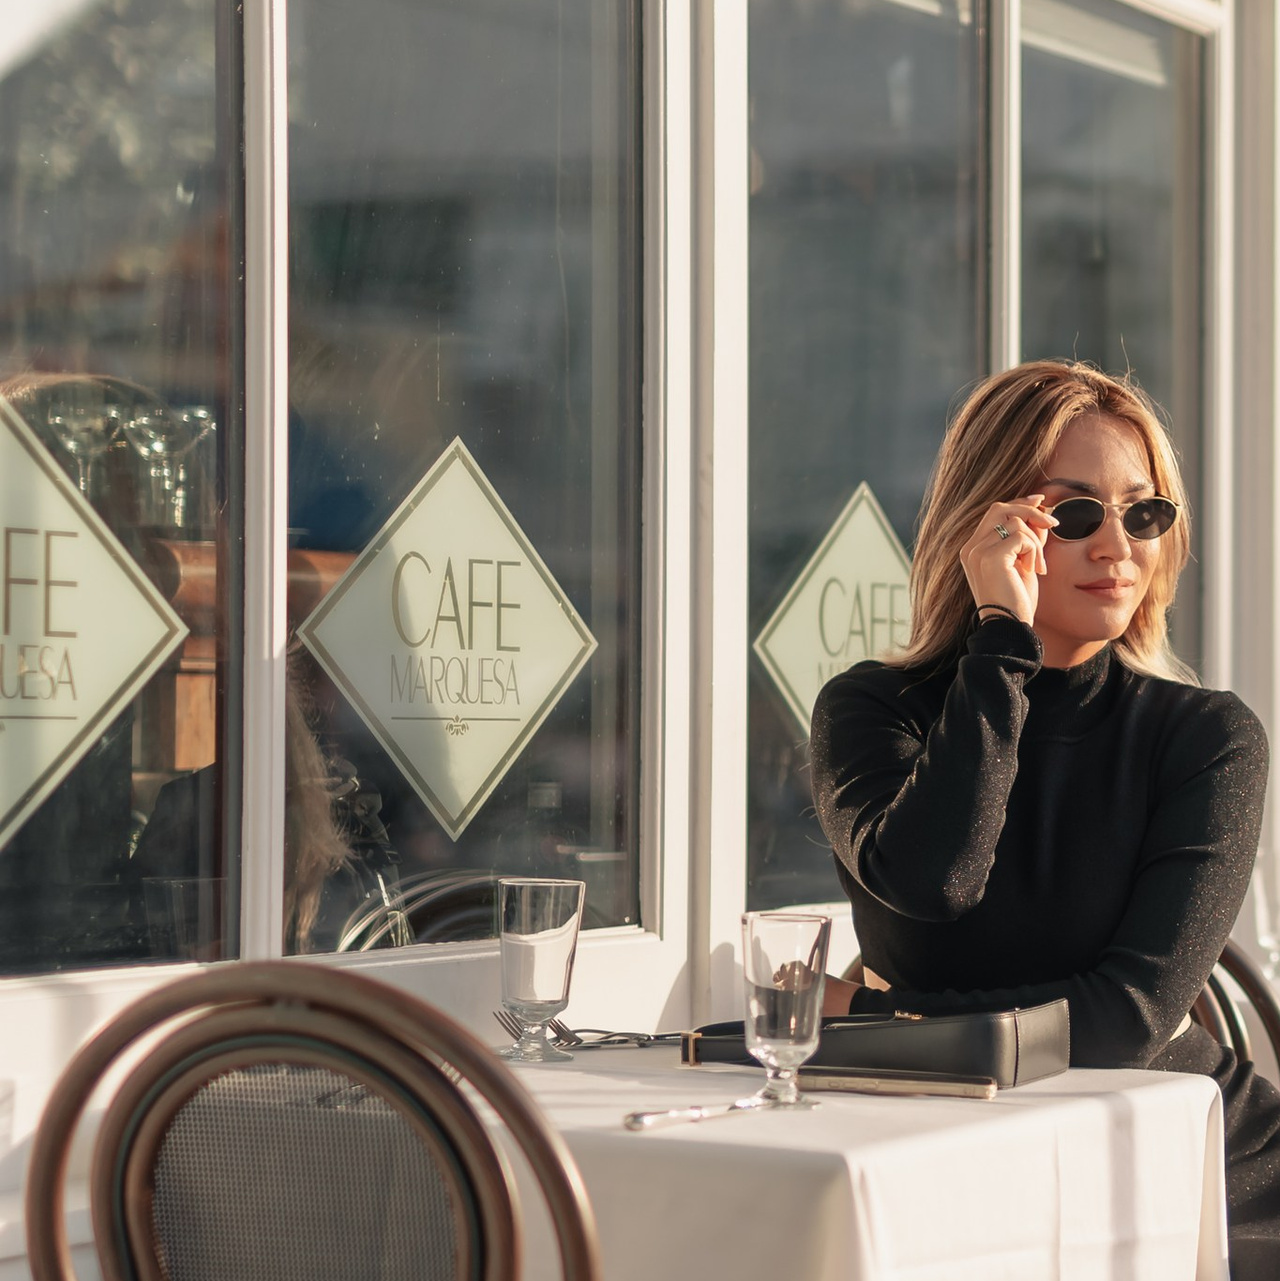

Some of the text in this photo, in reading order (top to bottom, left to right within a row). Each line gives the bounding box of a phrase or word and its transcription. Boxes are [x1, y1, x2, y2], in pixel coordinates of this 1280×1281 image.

[391, 550, 522, 652] CAFE
[0, 643, 78, 701] UESA
[390, 654, 521, 705] MARQUESA
